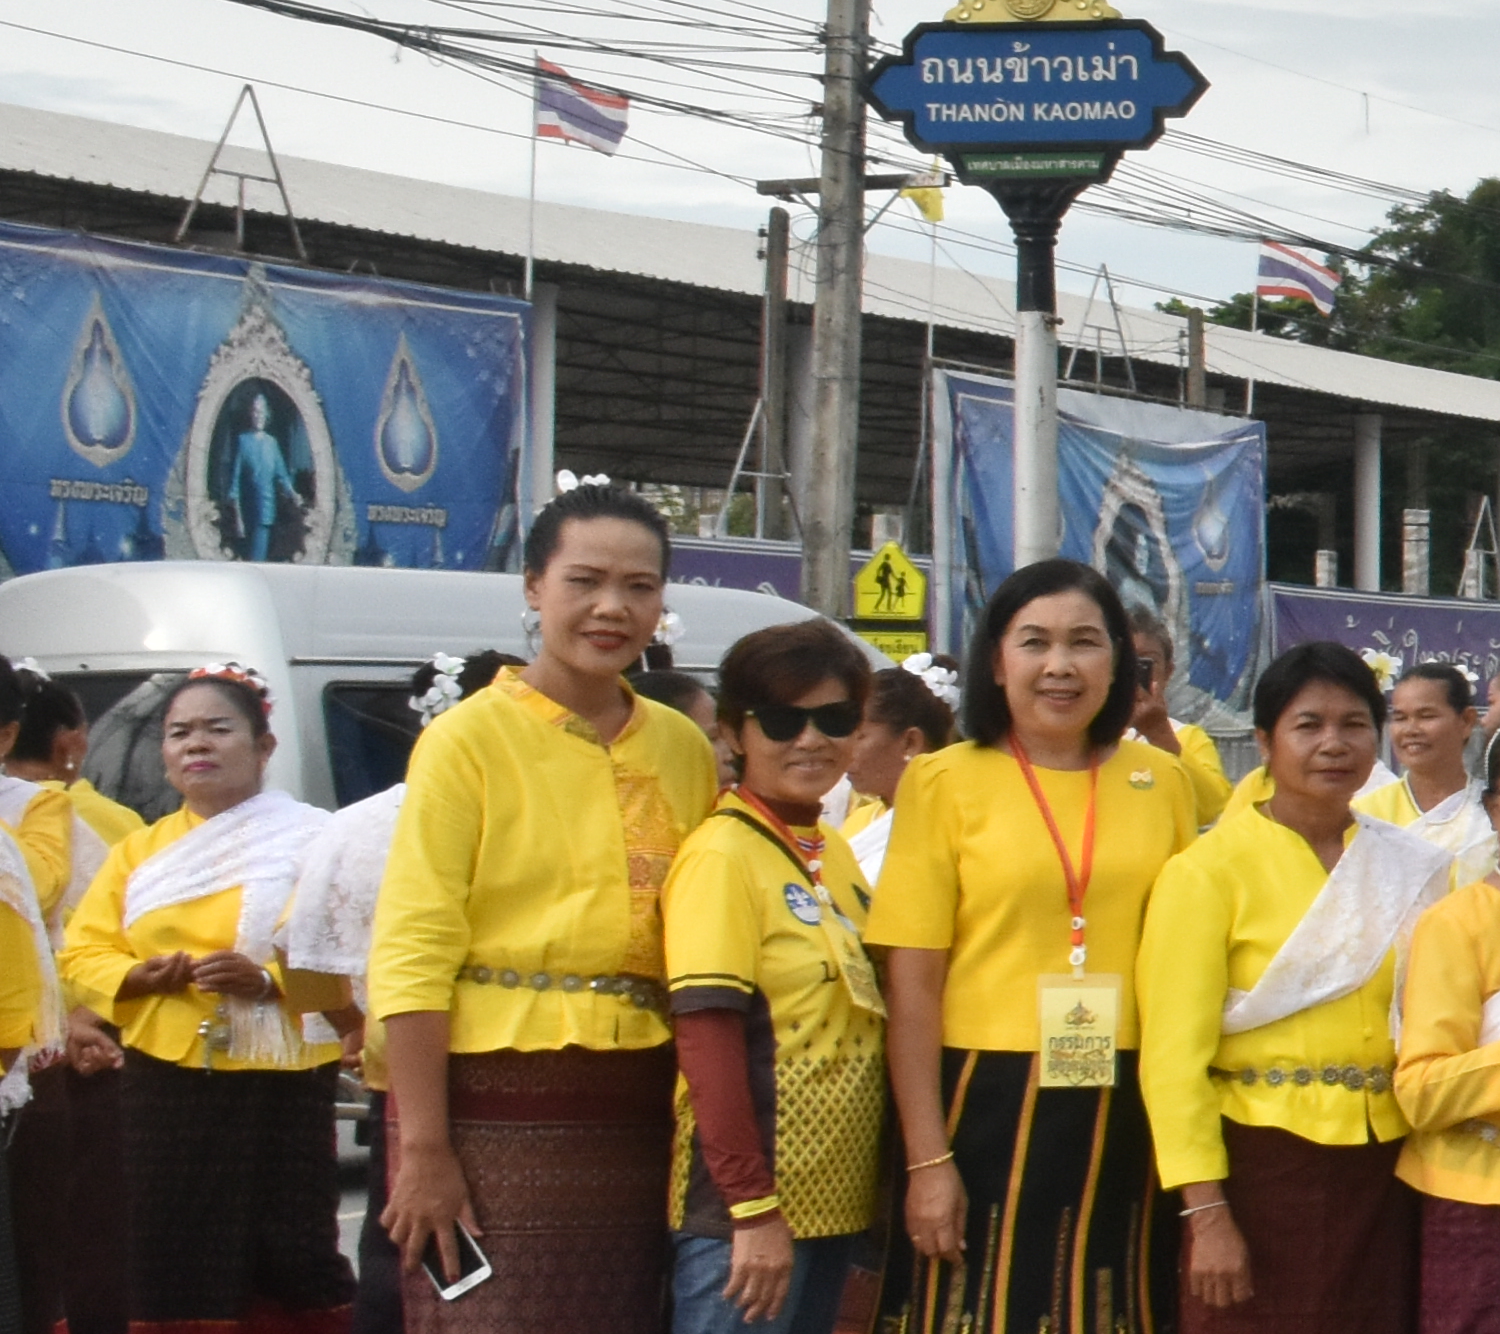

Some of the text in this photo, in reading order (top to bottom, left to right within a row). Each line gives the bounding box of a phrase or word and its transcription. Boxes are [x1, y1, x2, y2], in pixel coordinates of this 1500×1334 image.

[921, 41, 1139, 84] ถนนข้าวเม่า
[1034, 100, 1136, 121] KAOMAO
